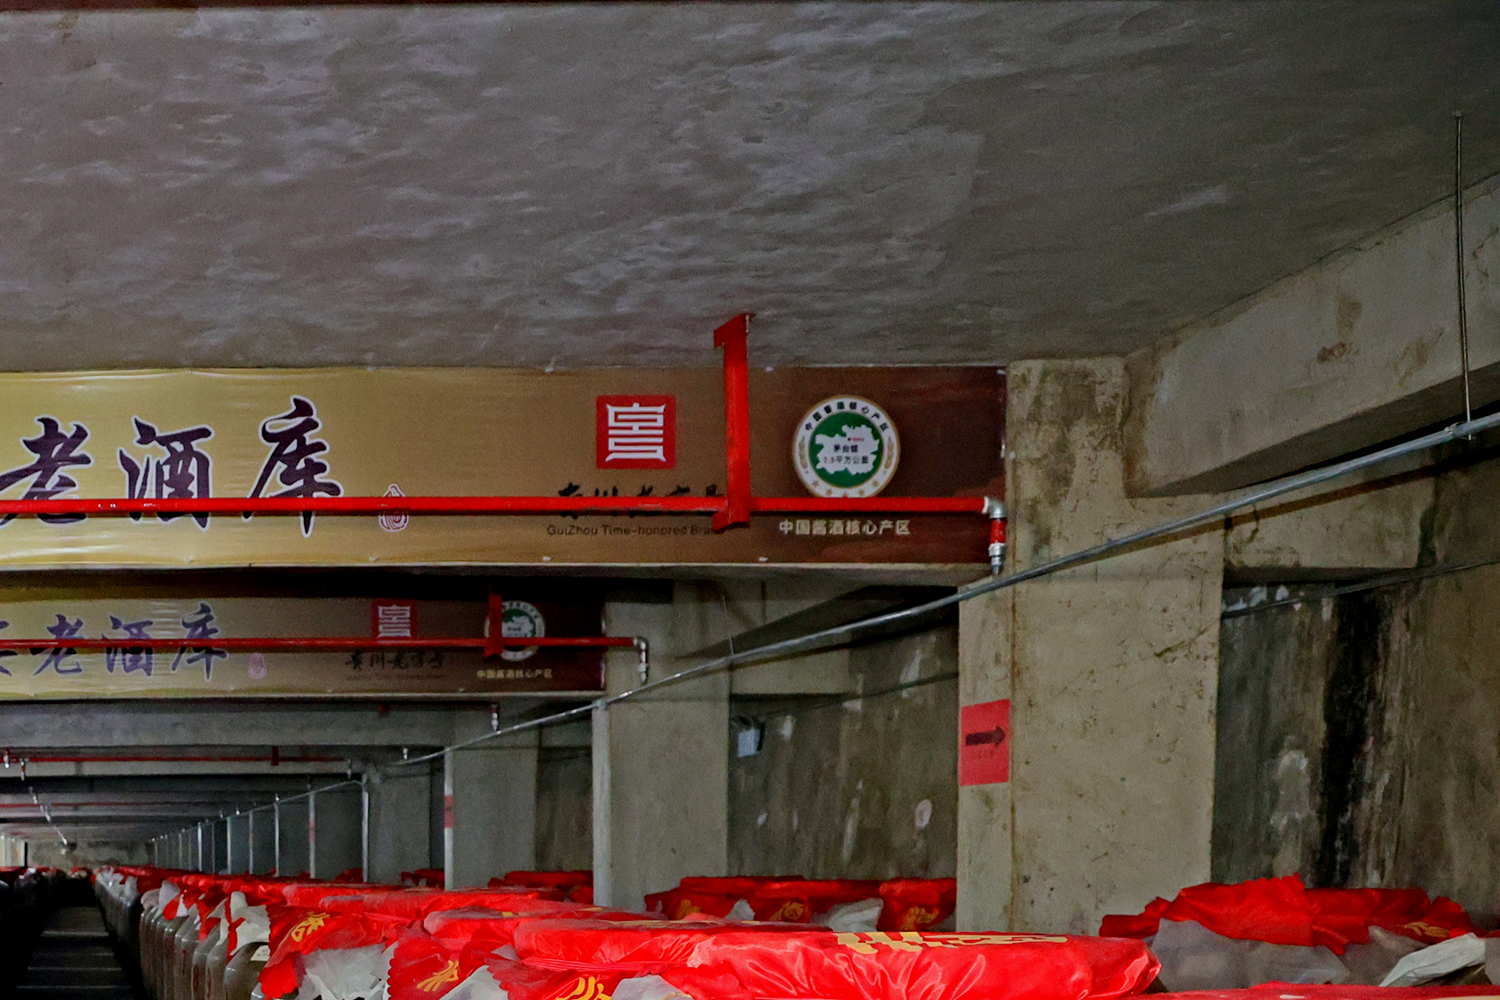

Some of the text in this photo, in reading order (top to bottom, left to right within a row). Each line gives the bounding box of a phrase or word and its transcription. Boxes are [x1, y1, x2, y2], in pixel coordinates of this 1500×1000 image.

[547, 524, 715, 536] GuiZhou Time-honored Bra
[779, 518, 911, 536] 中国酱酒核心产区
